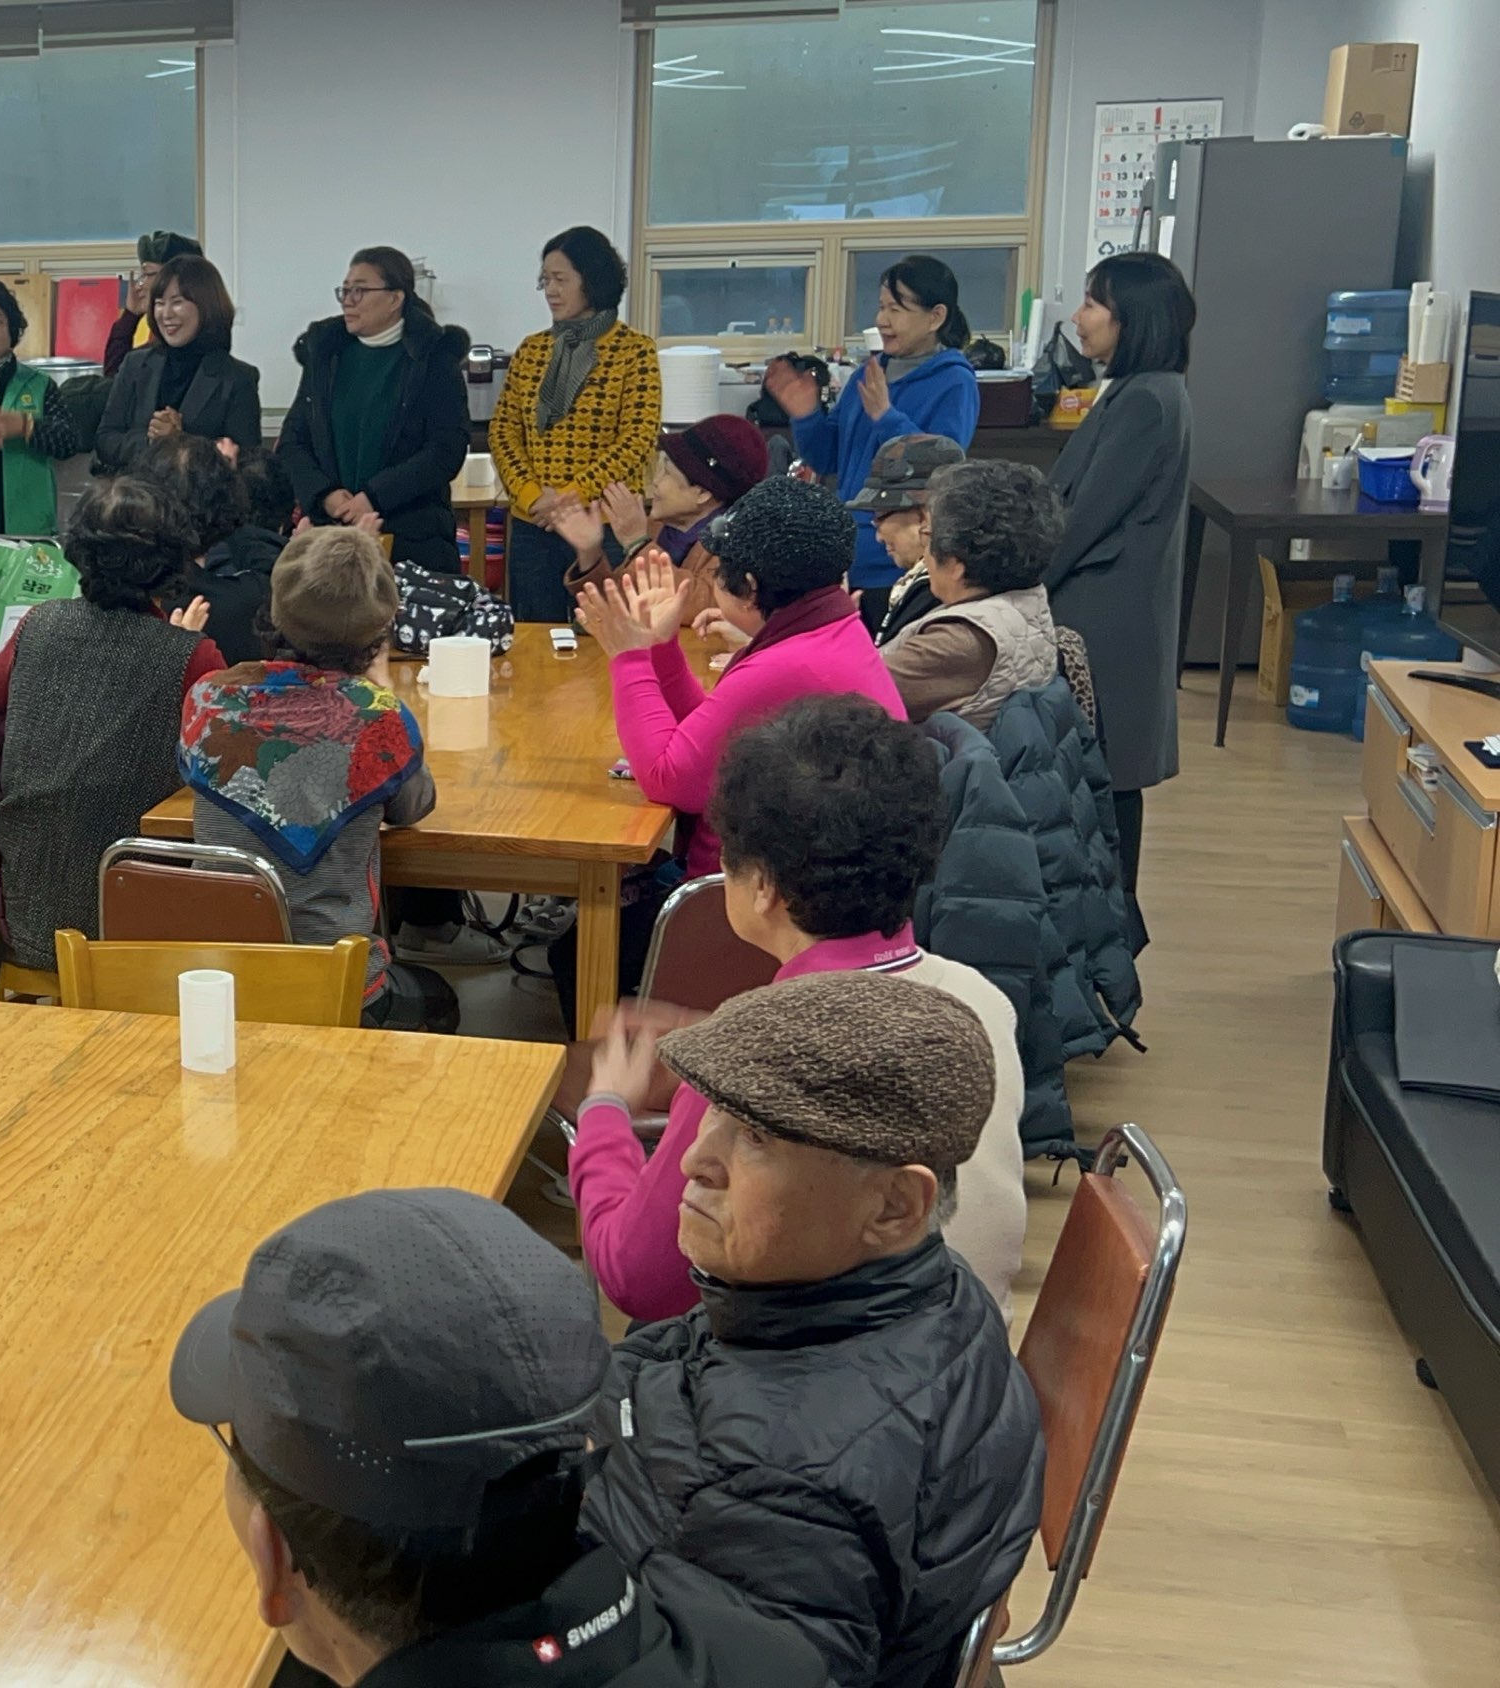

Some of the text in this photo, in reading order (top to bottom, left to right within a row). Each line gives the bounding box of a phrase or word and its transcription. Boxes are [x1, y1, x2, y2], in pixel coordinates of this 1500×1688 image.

[1104, 154, 1111, 163] 5
[1120, 153, 1127, 163] 6
[1136, 152, 1143, 162] 7
[1101, 172, 1112, 181] 12
[1117, 171, 1128, 180] 13
[1133, 171, 1143, 180] 14
[1100, 190, 1143, 199] 19 20 21
[1099, 207, 1110, 217] 26
[1115, 207, 1126, 217] 27
[21, 579, 52, 595] 삼광
[567, 1605, 620, 1648] SWISS
